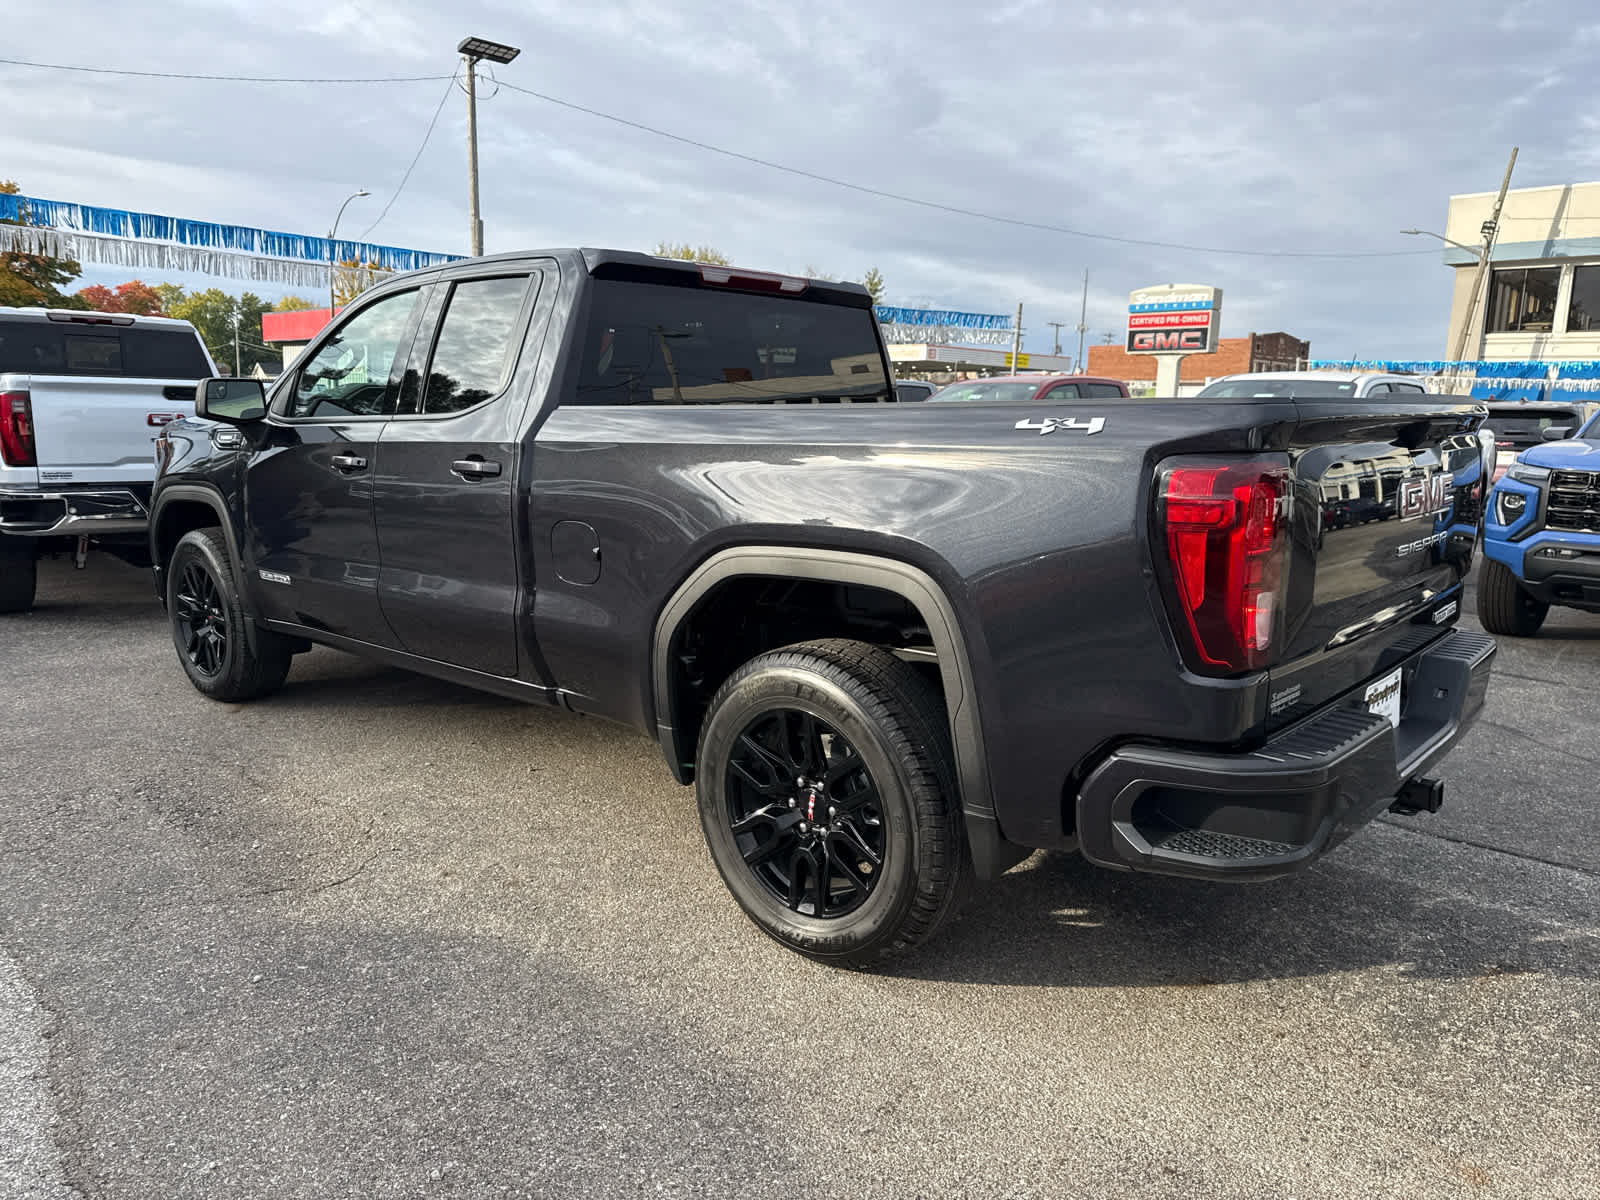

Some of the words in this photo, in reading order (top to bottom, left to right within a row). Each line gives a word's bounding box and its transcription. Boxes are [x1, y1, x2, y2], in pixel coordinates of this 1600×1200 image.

[1130, 316, 1165, 326] CERTIFIED
[1166, 314, 1208, 325] PRE-OWNED
[1133, 331, 1201, 349] GMC
[1400, 473, 1454, 518] GMC
[1397, 530, 1448, 557] SIERRA
